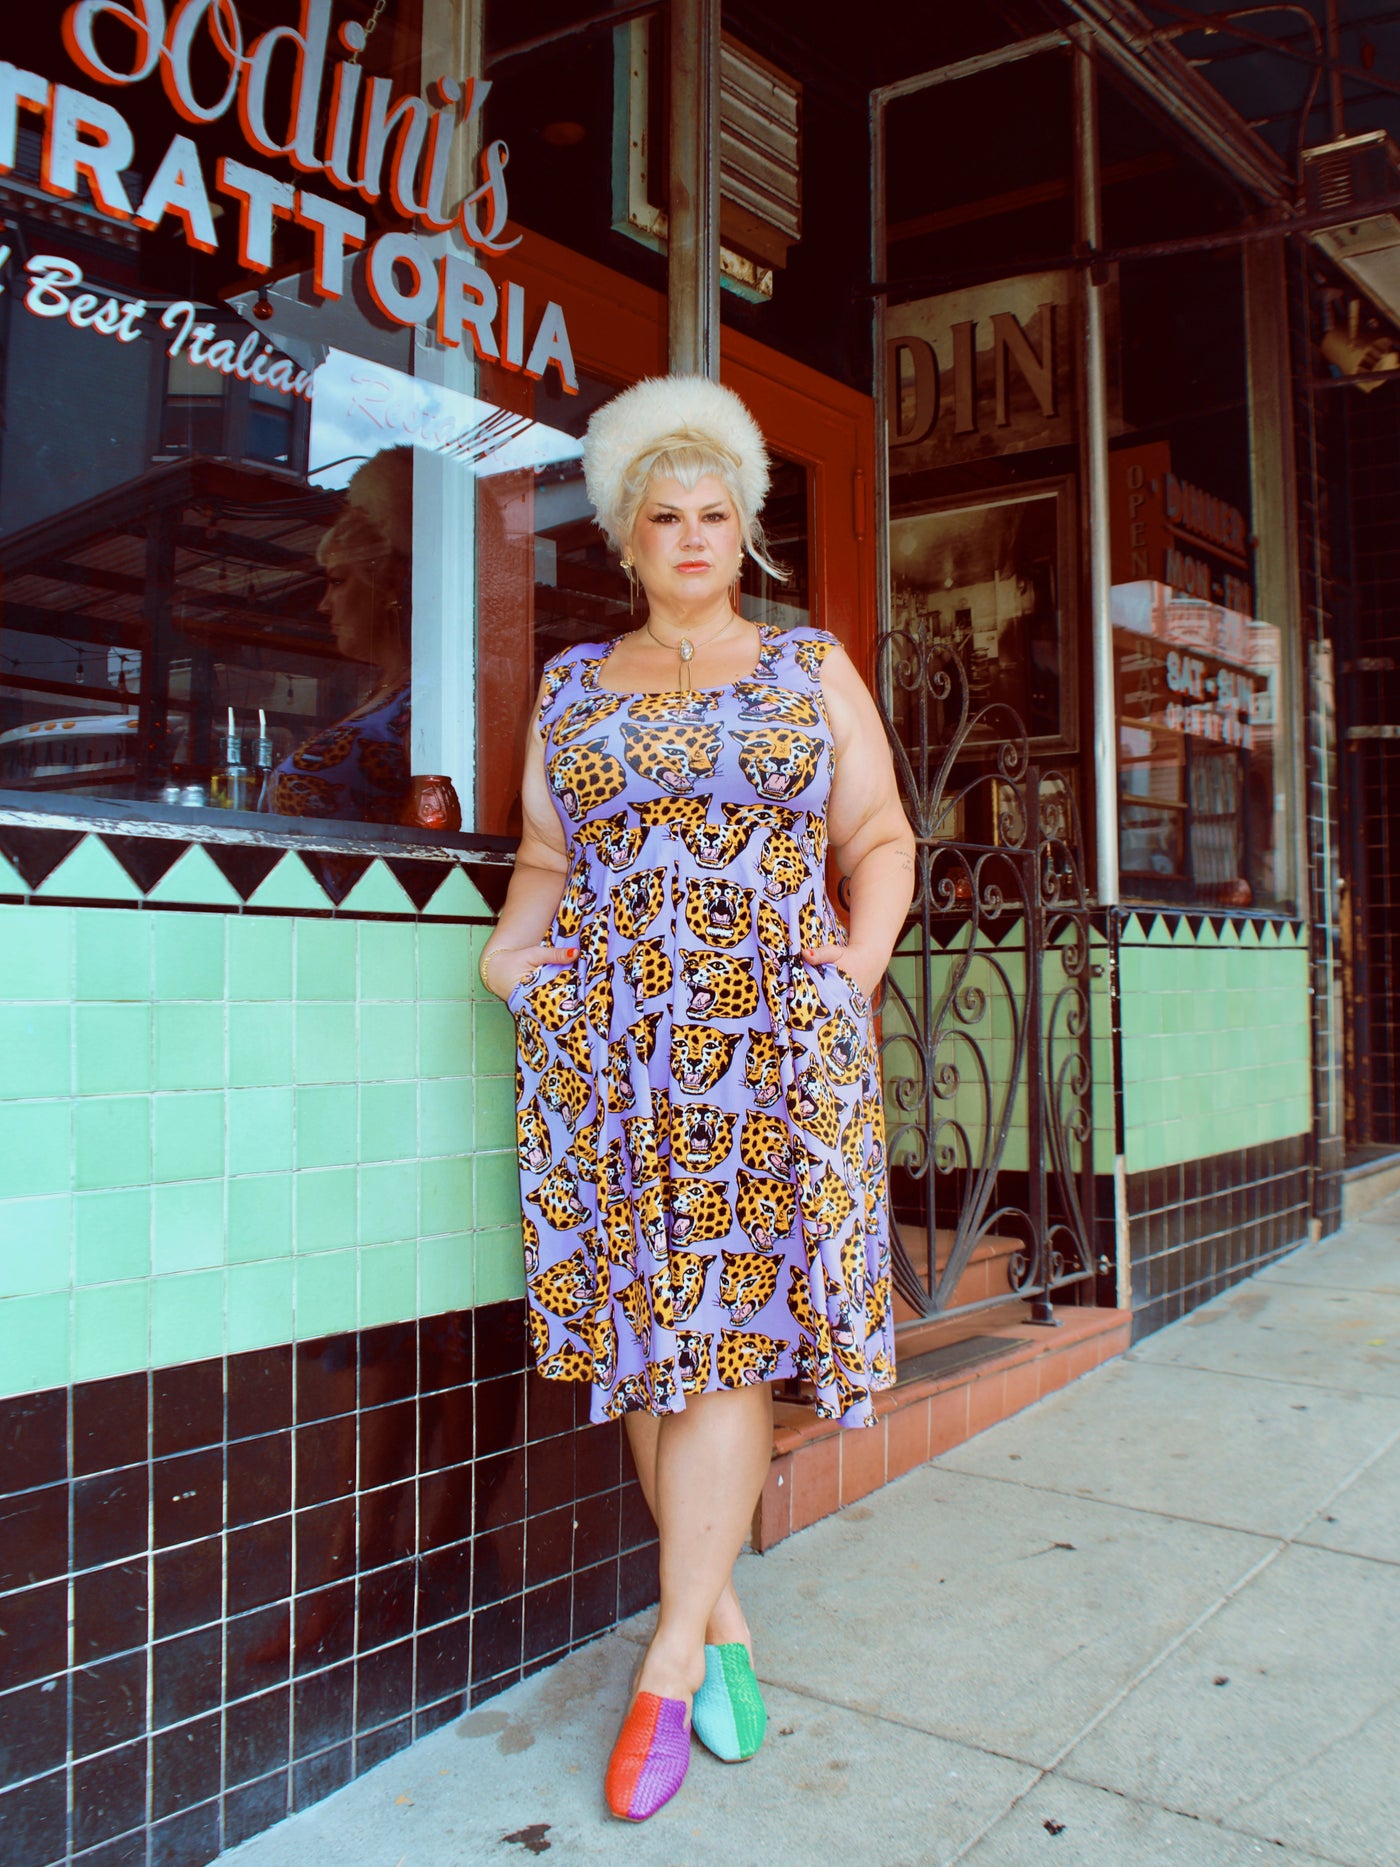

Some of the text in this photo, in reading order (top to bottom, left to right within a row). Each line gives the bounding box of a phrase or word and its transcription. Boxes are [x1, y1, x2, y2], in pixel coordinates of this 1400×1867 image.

[24, 254, 147, 343] Best
[160, 300, 318, 401] Italian
[1126, 464, 1149, 578] OPEN
[1164, 472, 1247, 557] DINNER
